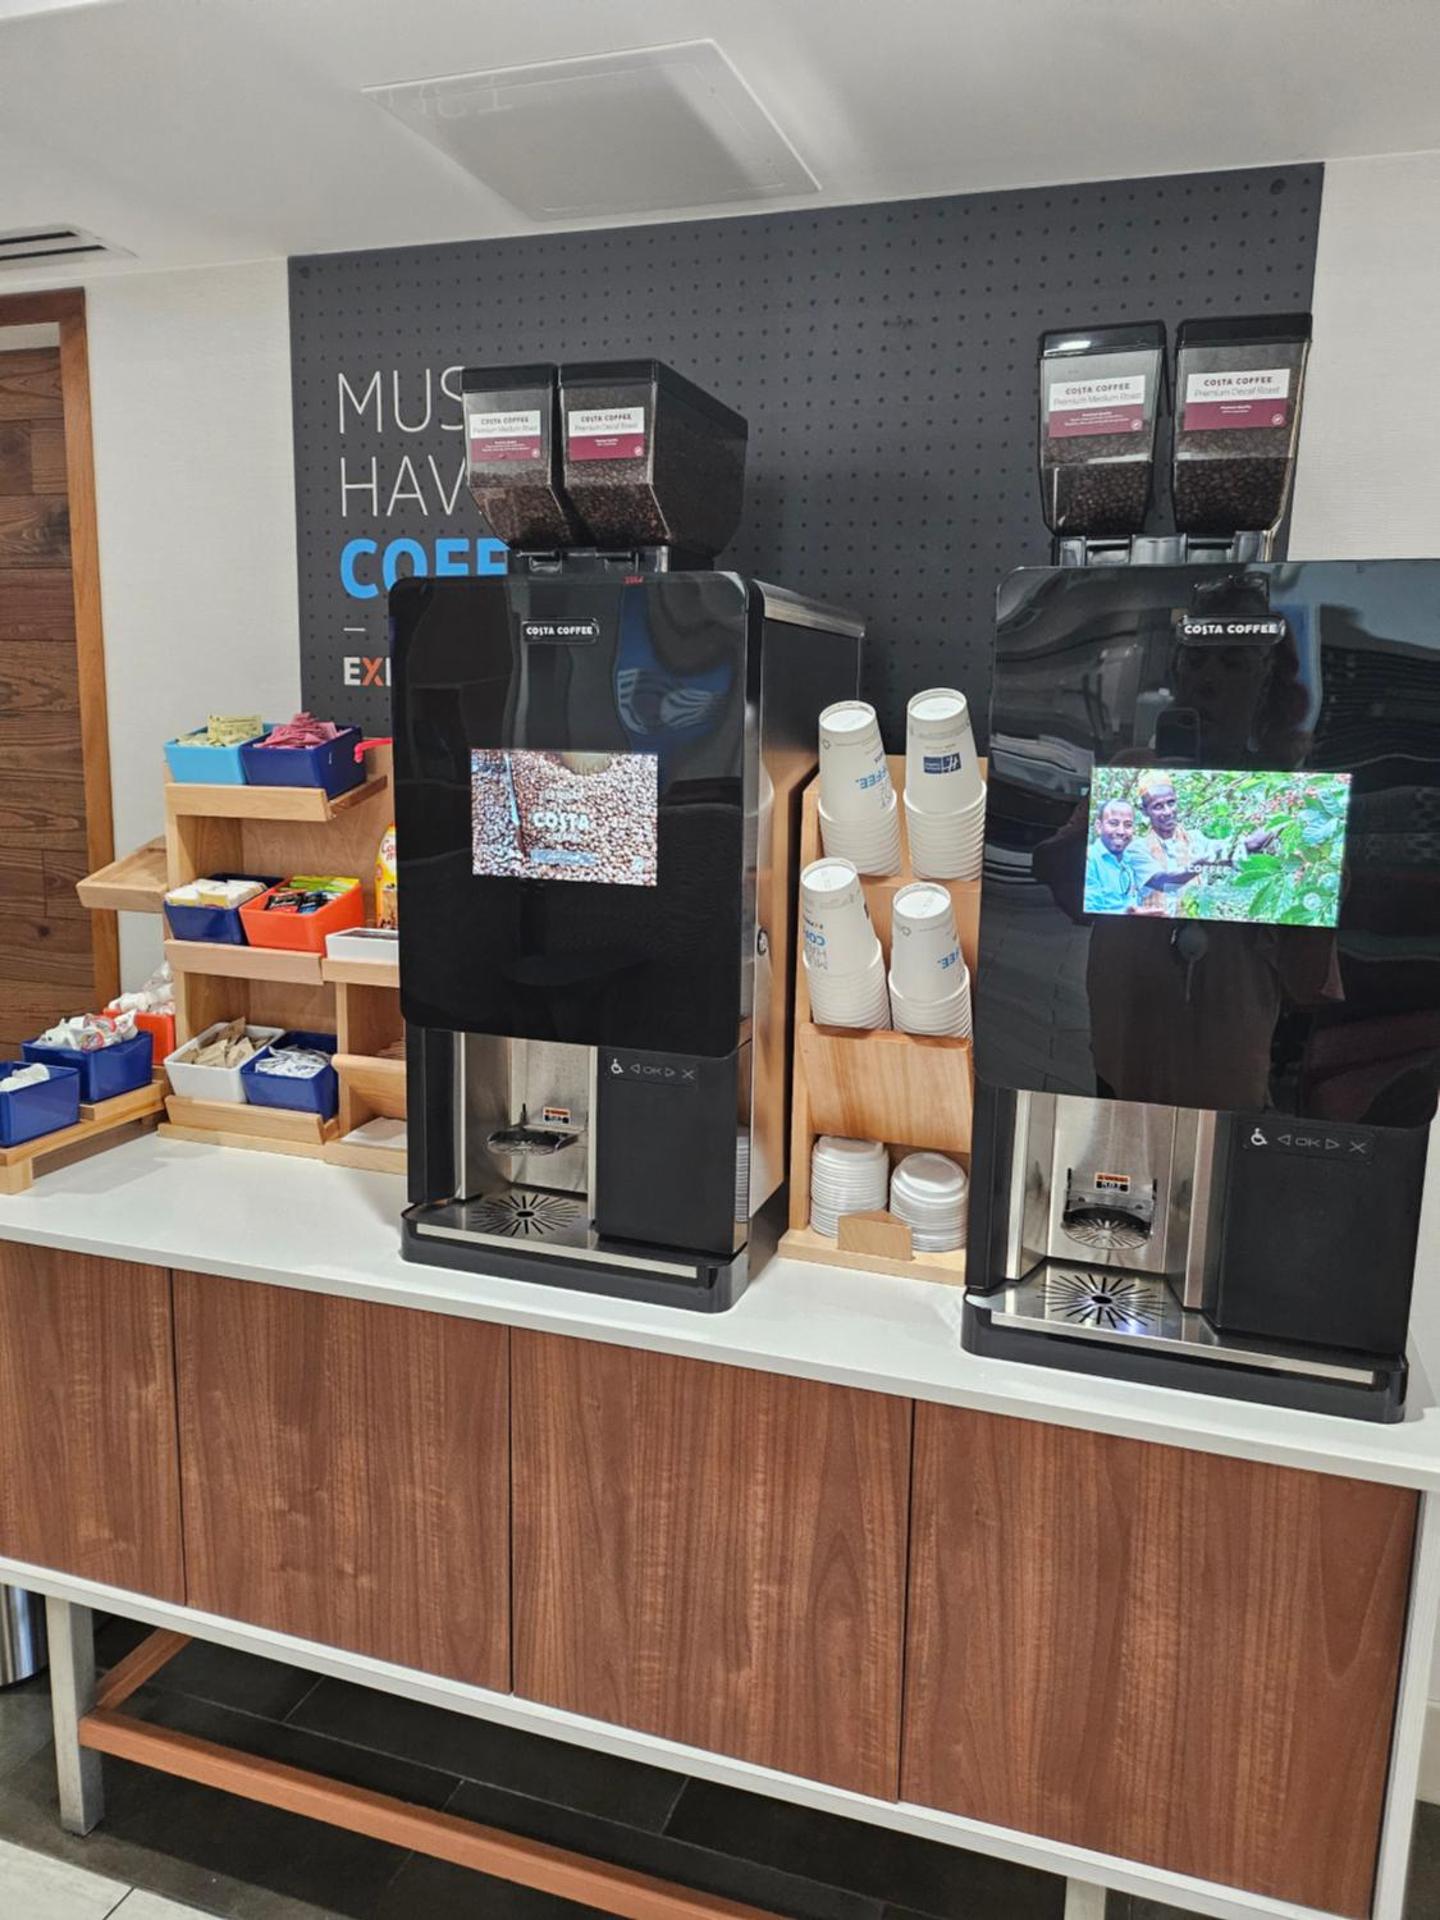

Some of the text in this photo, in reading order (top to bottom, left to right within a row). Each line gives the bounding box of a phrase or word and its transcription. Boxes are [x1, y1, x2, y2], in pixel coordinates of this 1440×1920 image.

[1203, 375, 1273, 387] COSTA COFFEE
[1064, 382, 1131, 396] COSTA COFFEE
[503, 416, 529, 424] COFFEE
[580, 412, 632, 423] COSTA COFFEE
[525, 625, 594, 637] COSTA COFFEE
[1183, 623, 1278, 636] COSTA COFFEE
[532, 811, 590, 831] COSTA
[1294, 1137, 1321, 1148] OK
